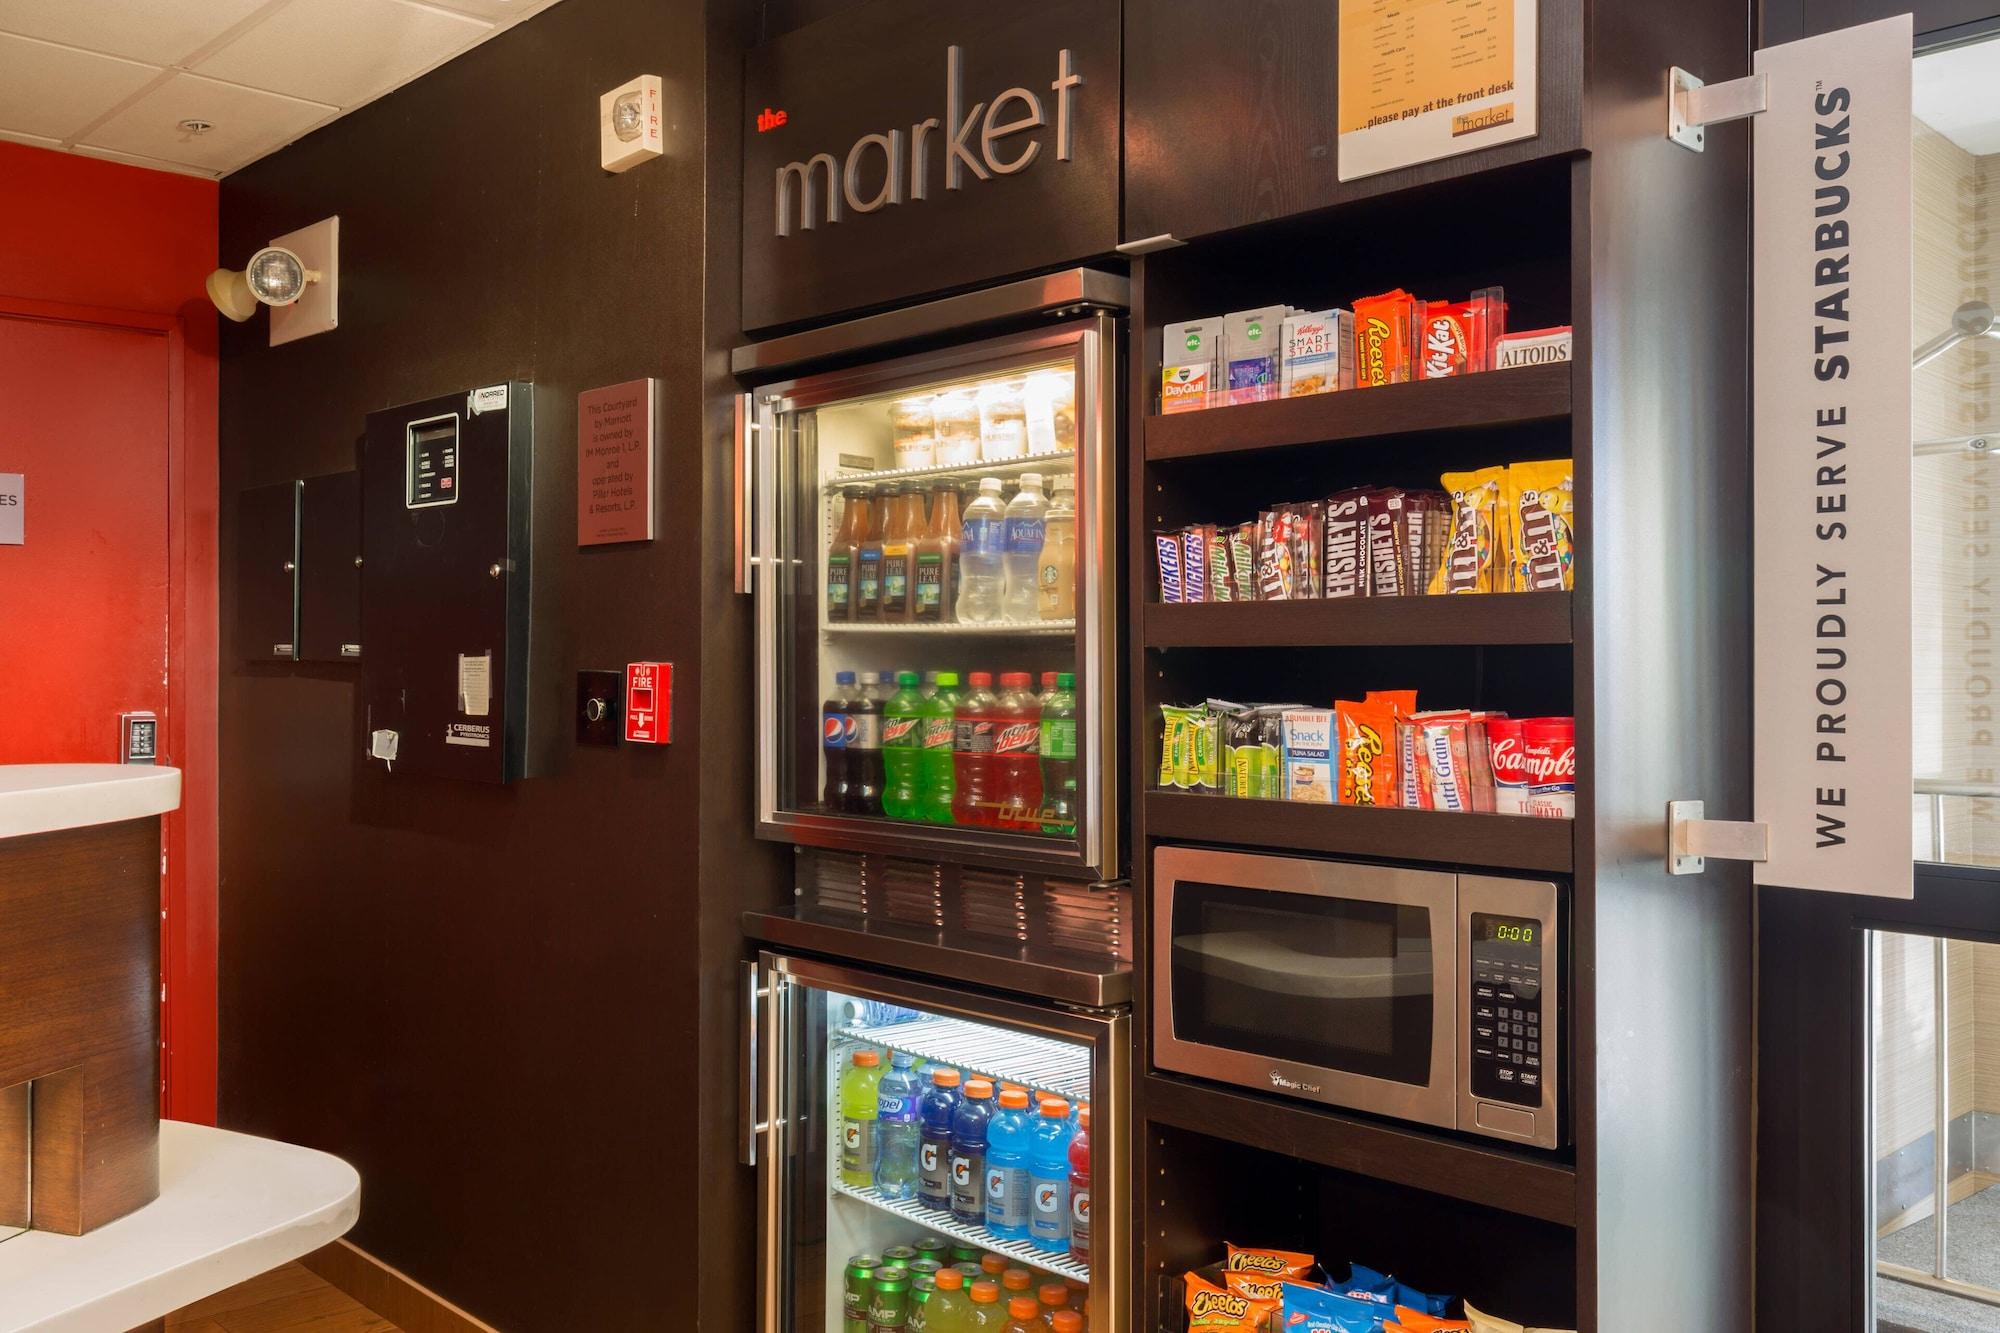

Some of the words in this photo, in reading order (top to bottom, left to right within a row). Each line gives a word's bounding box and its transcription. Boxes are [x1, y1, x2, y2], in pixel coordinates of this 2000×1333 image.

[1402, 106, 1420, 120] pay
[1423, 102, 1434, 113] at
[1437, 97, 1454, 109] the
[1457, 87, 1486, 104] front
[1488, 80, 1514, 95] desk
[649, 90, 658, 138] FIRE
[757, 107, 788, 133] the
[1462, 108, 1511, 131] market
[775, 45, 1084, 237] market
[1186, 338, 1201, 346] etc.
[1248, 328, 1263, 336] etc.
[1289, 333, 1332, 348] SMART
[1289, 342, 1333, 357] START
[1367, 317, 1391, 387] Reese's
[1501, 344, 1567, 367] ALTOIDS
[1165, 382, 1204, 396] DayQuil
[588, 403, 602, 415] This
[603, 398, 638, 412] Courtyard
[600, 430, 623, 441] owned
[624, 428, 634, 439] by
[606, 460, 619, 469] and
[1816, 406, 1847, 540] SERVE
[1011, 527, 1044, 540] AQUAFIN
[1326, 498, 1358, 599] ERSHEY'S
[1158, 538, 1181, 604] NICKERS
[1185, 532, 1204, 604] NICKERS
[1816, 563, 1847, 762] PROUDLY
[632, 677, 652, 687] FIRE
[454, 724, 490, 733] CERBERUS
[1290, 729, 1324, 742] Snack
[1433, 737, 1450, 777] Grain
[1441, 781, 1460, 809] utri
[1816, 787, 1847, 849] WE
[1497, 925, 1533, 942] 0:00
[1280, 1078, 1301, 1089] Magic
[1302, 1083, 1320, 1093] Chef
[921, 1144, 937, 1171] G
[952, 1157, 969, 1185] G
[987, 1170, 1004, 1198] G
[1035, 1184, 1057, 1213] G
[1230, 1253, 1287, 1271] Cheetos
[845, 1292, 860, 1301] MP
[1192, 1291, 1247, 1317] Cheetos
[868, 1305, 897, 1319] AMP
[908, 1315, 926, 1329] AM
